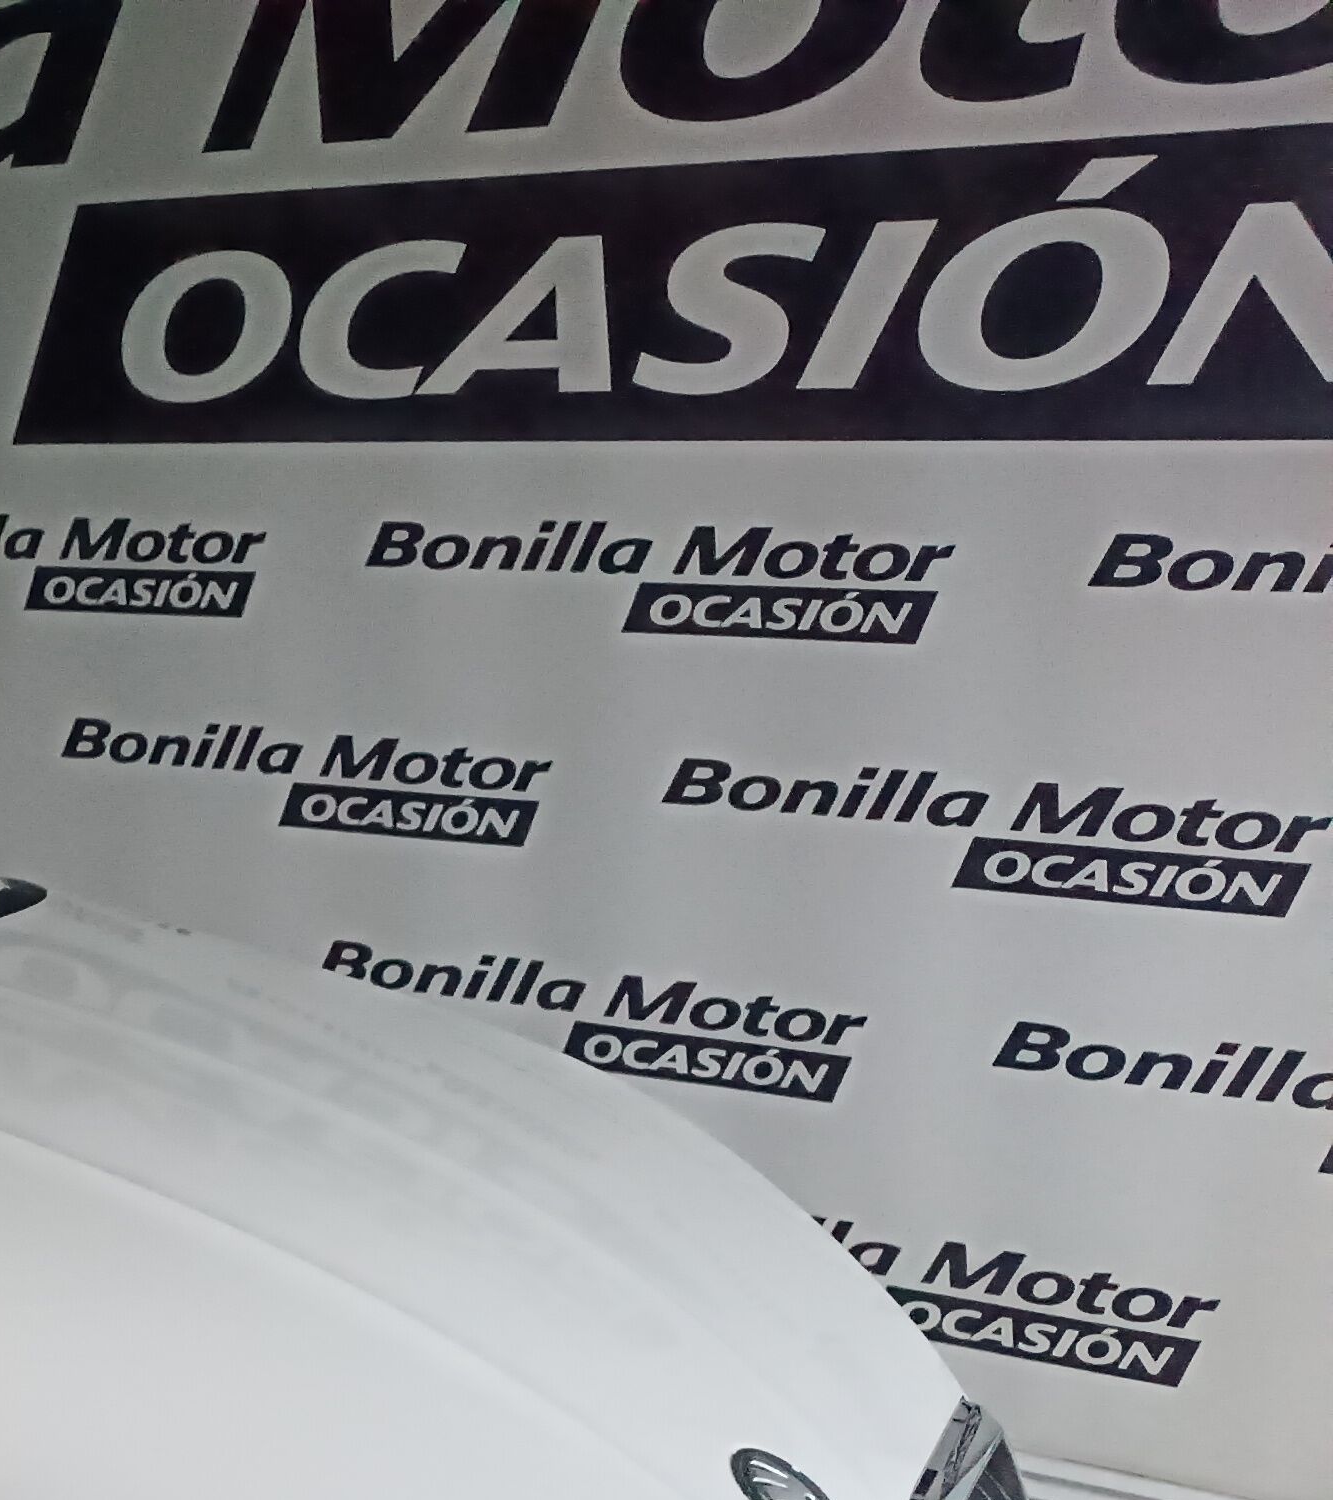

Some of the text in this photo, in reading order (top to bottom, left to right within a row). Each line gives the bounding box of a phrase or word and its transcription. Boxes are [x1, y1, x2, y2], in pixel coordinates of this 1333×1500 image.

[60, 517, 266, 564] Motor
[366, 520, 956, 582] Bonilla Motor
[44, 573, 239, 611] OCASIÓN
[649, 593, 913, 633] OCASIÓN
[61, 717, 552, 792] Bonilla Motor
[300, 793, 520, 838] OCASIÓN
[661, 757, 1333, 853] Bonilla Motor
[983, 850, 1283, 906] OCASIÓN
[322, 940, 868, 1046] Bonilla Motor
[583, 1034, 829, 1093] OCASIÓN
[920, 1241, 1221, 1328] Motor
[901, 1300, 1175, 1376] OCASIÓN
